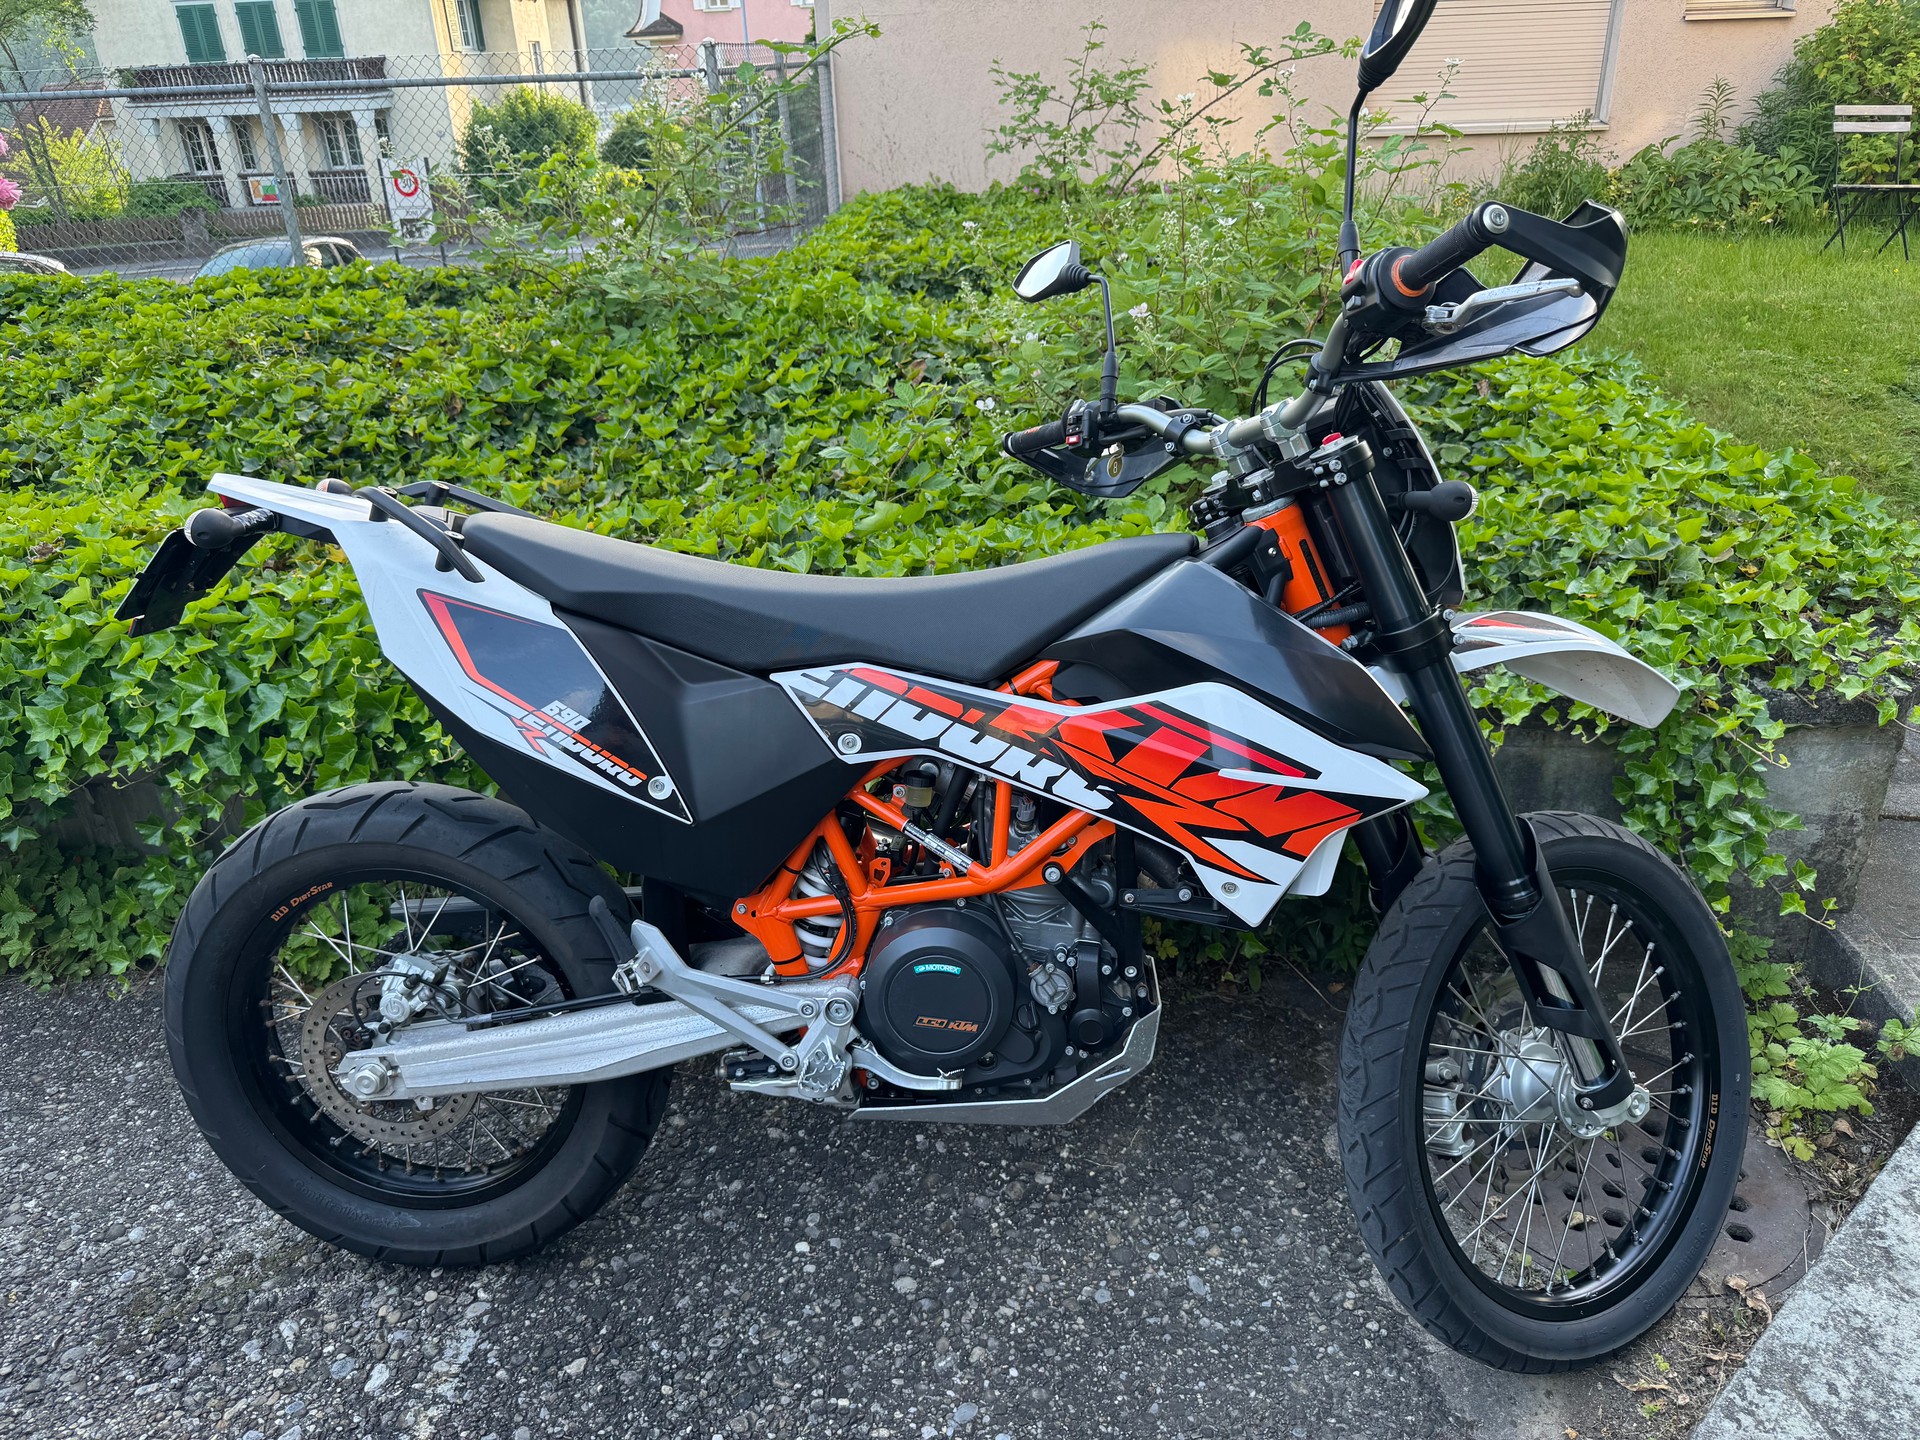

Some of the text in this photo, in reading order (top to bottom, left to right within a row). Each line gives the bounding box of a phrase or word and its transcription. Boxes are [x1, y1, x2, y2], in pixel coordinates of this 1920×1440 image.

[402, 176, 412, 189] 30
[541, 700, 592, 732] 690
[522, 711, 648, 787] ENDURO
[270, 905, 289, 922] DID
[925, 963, 959, 974] MOTOREX
[948, 1020, 979, 1033] KTM
[1710, 1093, 1719, 1115] DID
